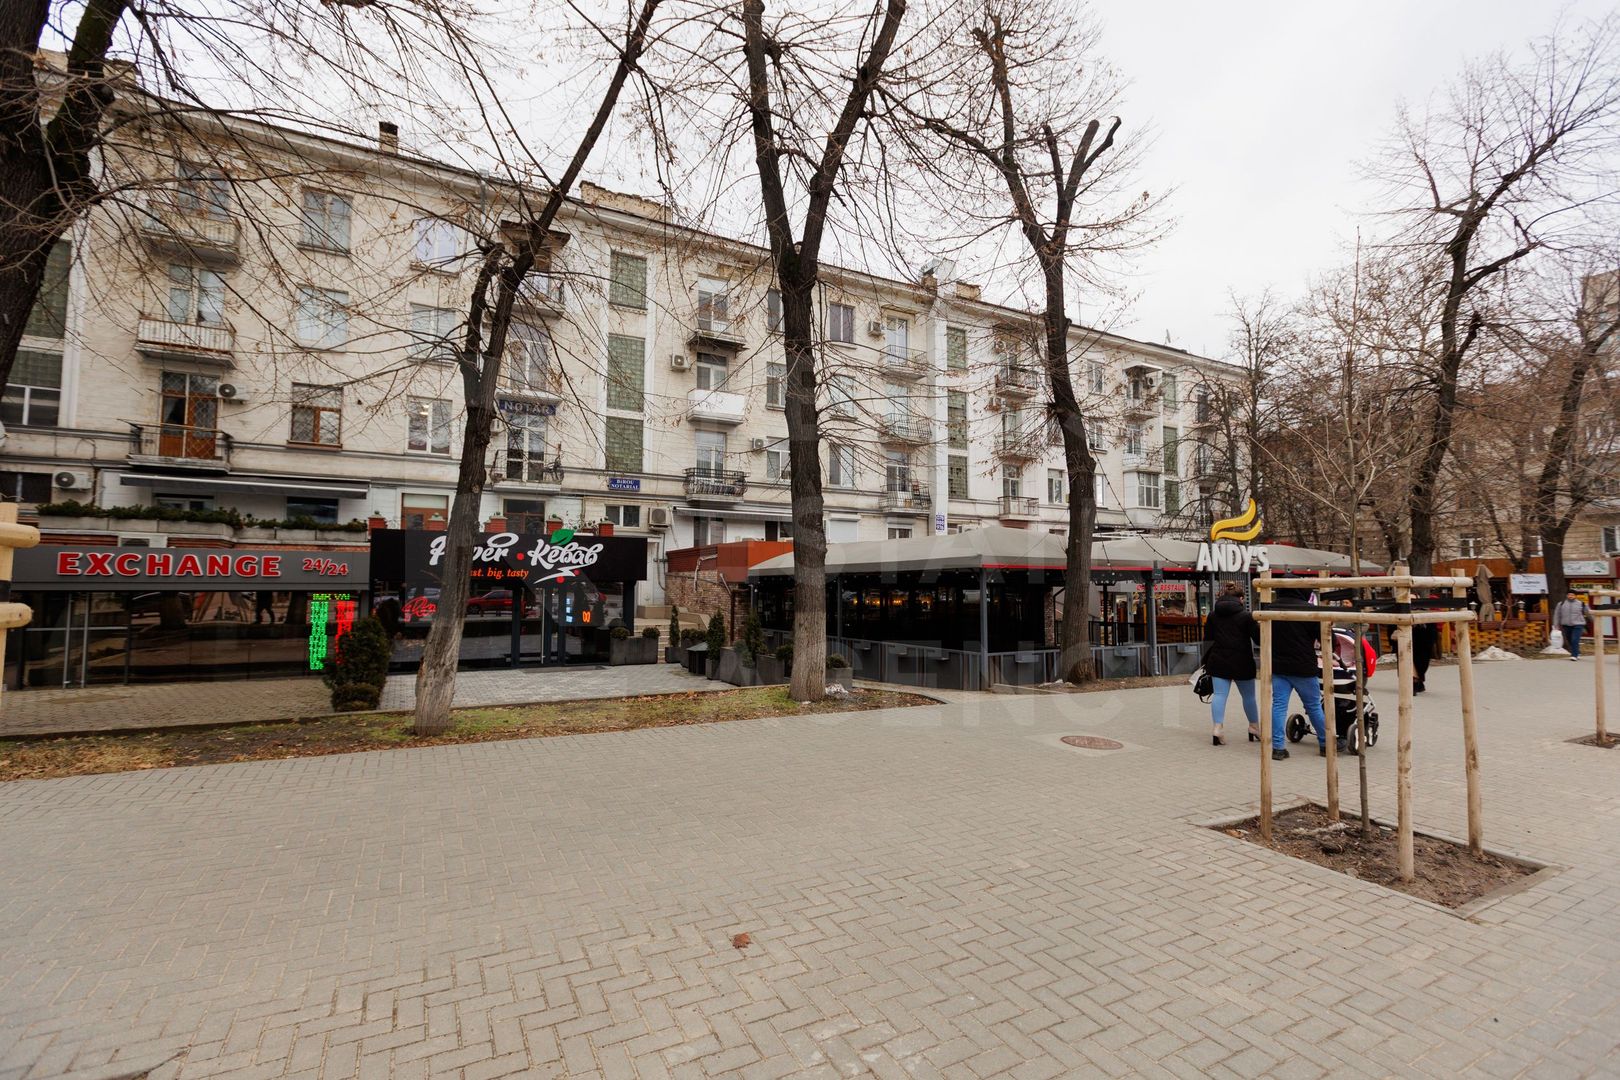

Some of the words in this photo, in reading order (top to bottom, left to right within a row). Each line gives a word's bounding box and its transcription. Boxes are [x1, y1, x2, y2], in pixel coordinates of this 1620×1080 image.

[504, 400, 551, 415] NOTAR
[57, 551, 282, 578] EXCHANGE
[302, 557, 349, 577] 24/24
[527, 538, 604, 570] Kebab
[1196, 542, 1270, 573] ANDY'S
[507, 567, 530, 580] tasty
